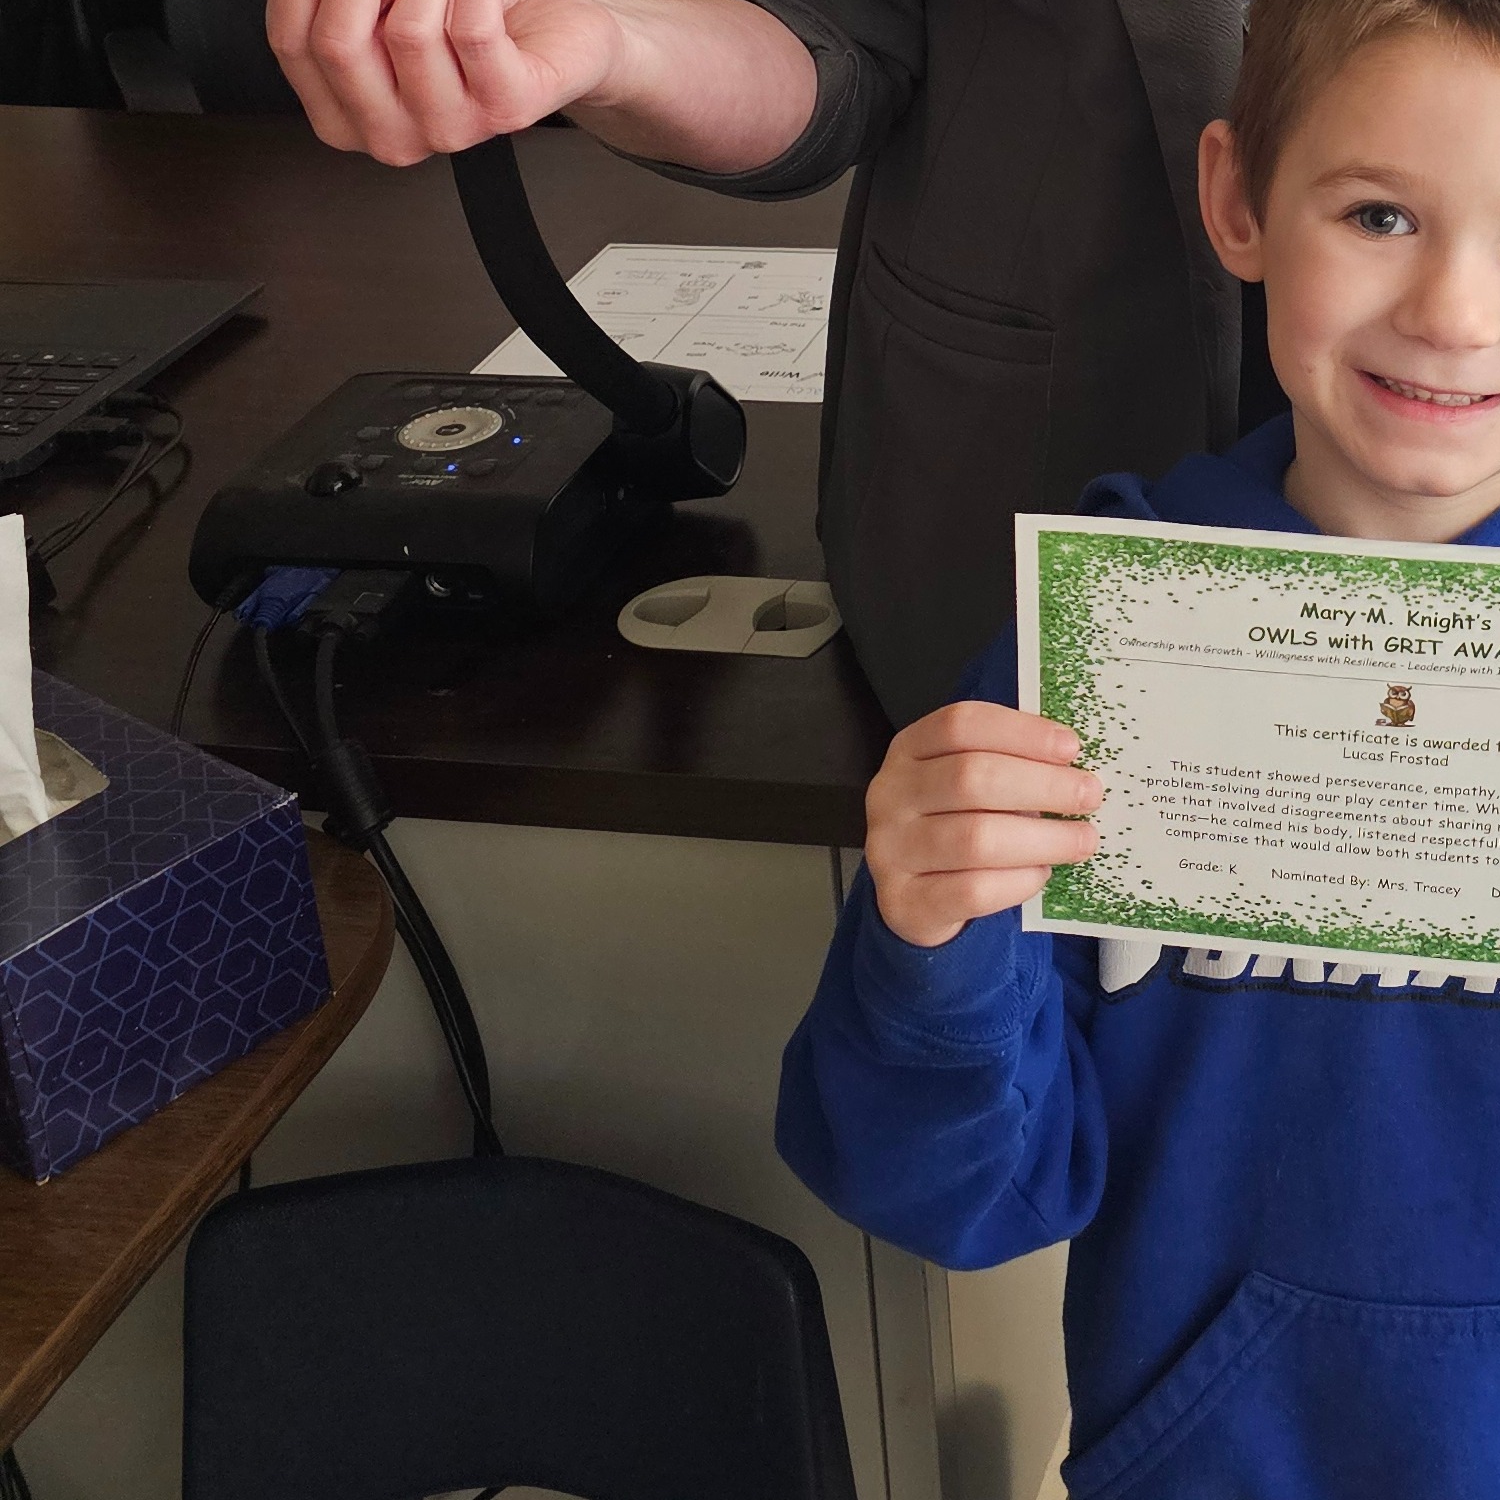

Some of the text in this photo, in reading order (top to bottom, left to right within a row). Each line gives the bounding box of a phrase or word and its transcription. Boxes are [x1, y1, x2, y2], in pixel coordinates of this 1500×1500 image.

[1298, 601, 1492, 634] Mary M. Knight's
[1247, 625, 1318, 647] OWLS
[1327, 632, 1374, 652] with
[1382, 635, 1444, 656] GRIT
[1341, 745, 1449, 767] Lucas Frostad
[1150, 794, 1176, 804] one
[1180, 793, 1213, 808] that
[1217, 796, 1276, 814] involved
[1280, 802, 1387, 824] disagreements
[1391, 813, 1434, 828] about
[1436, 816, 1492, 835] sharing
